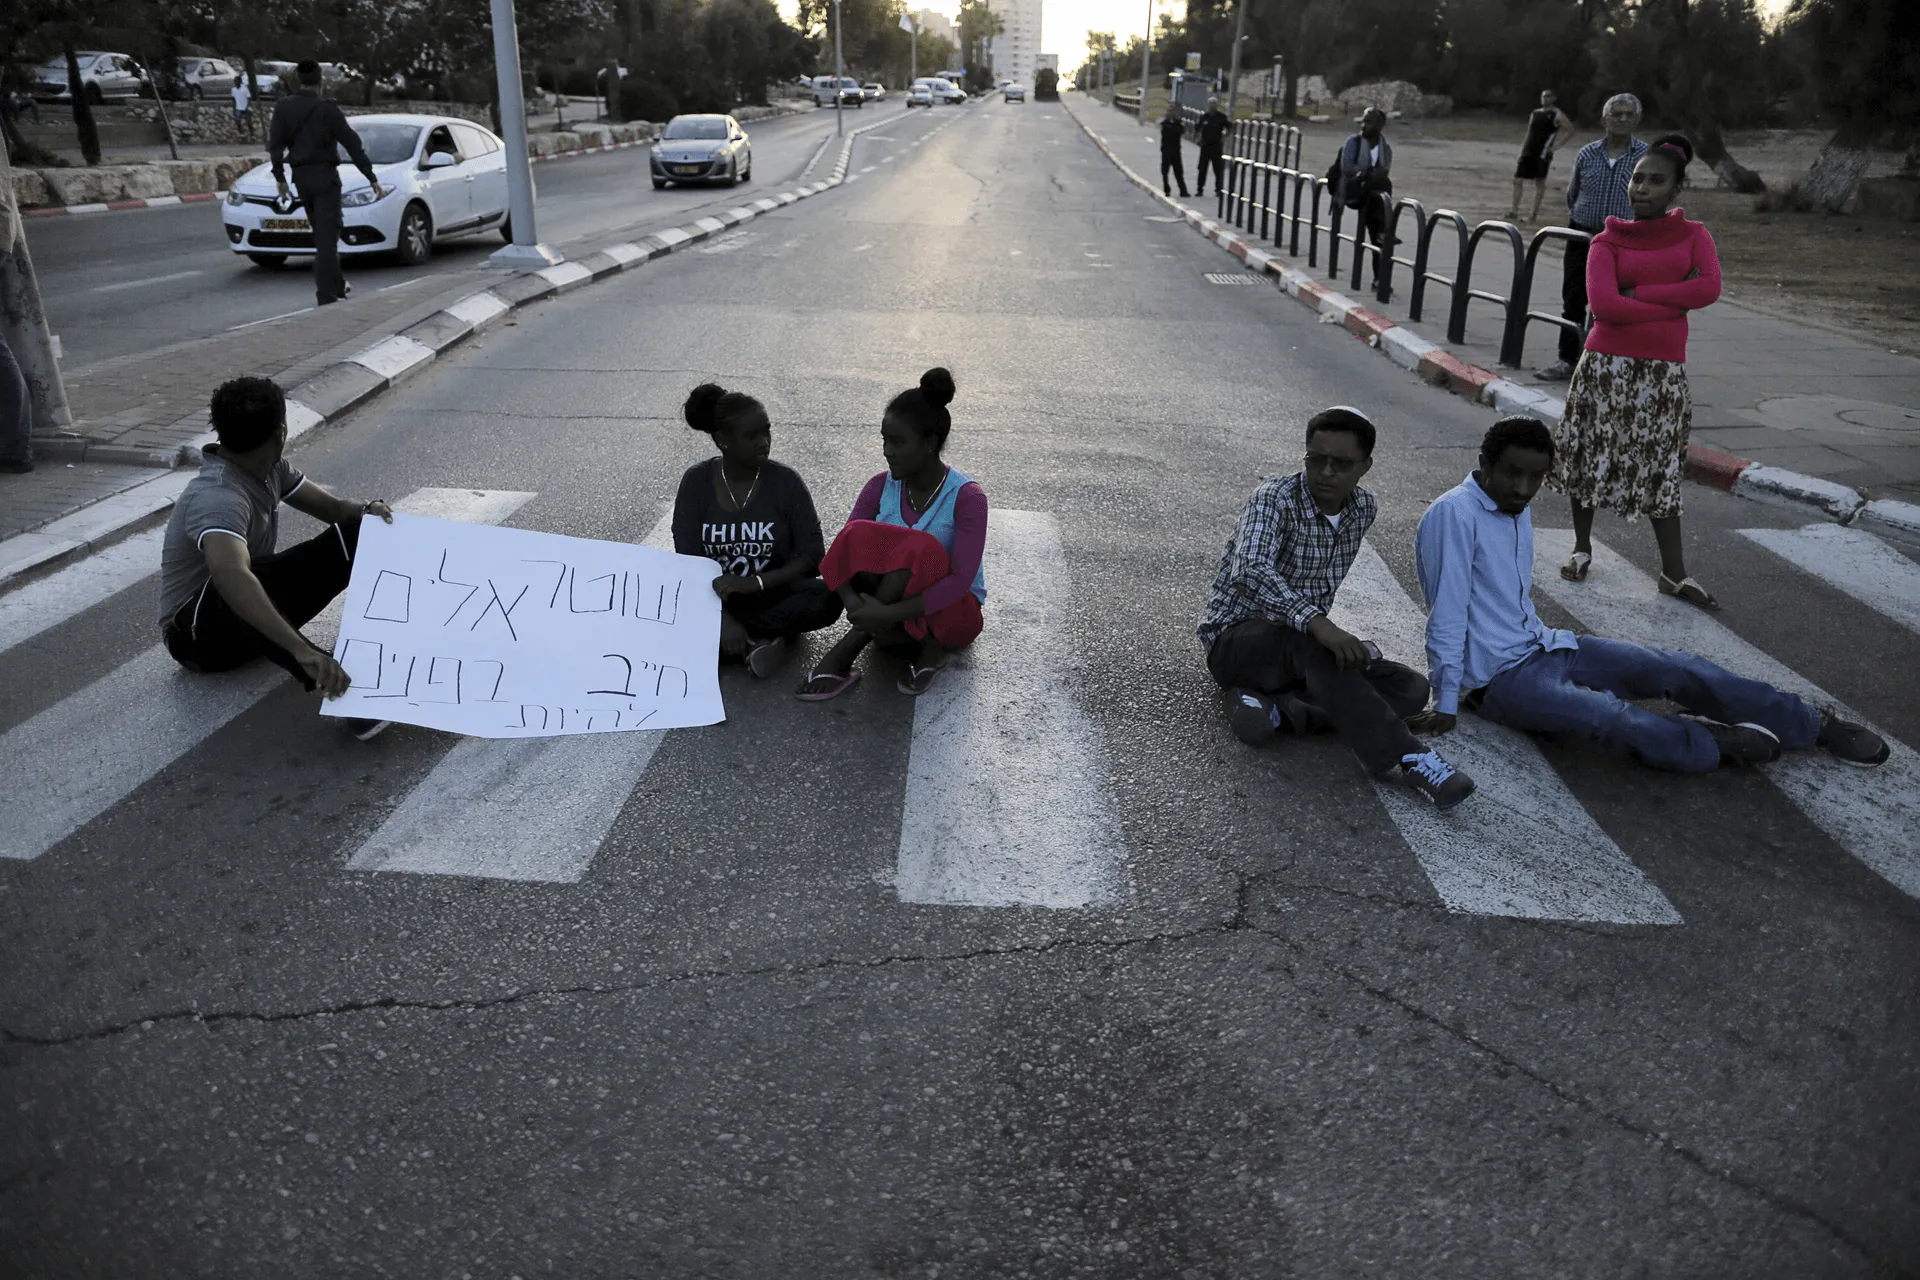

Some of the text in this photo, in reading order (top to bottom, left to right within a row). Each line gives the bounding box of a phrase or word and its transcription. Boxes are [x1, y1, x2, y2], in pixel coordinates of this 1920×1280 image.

[702, 521, 775, 542] THINK
[587, 654, 688, 698] חייב
[505, 703, 658, 730] להיות
